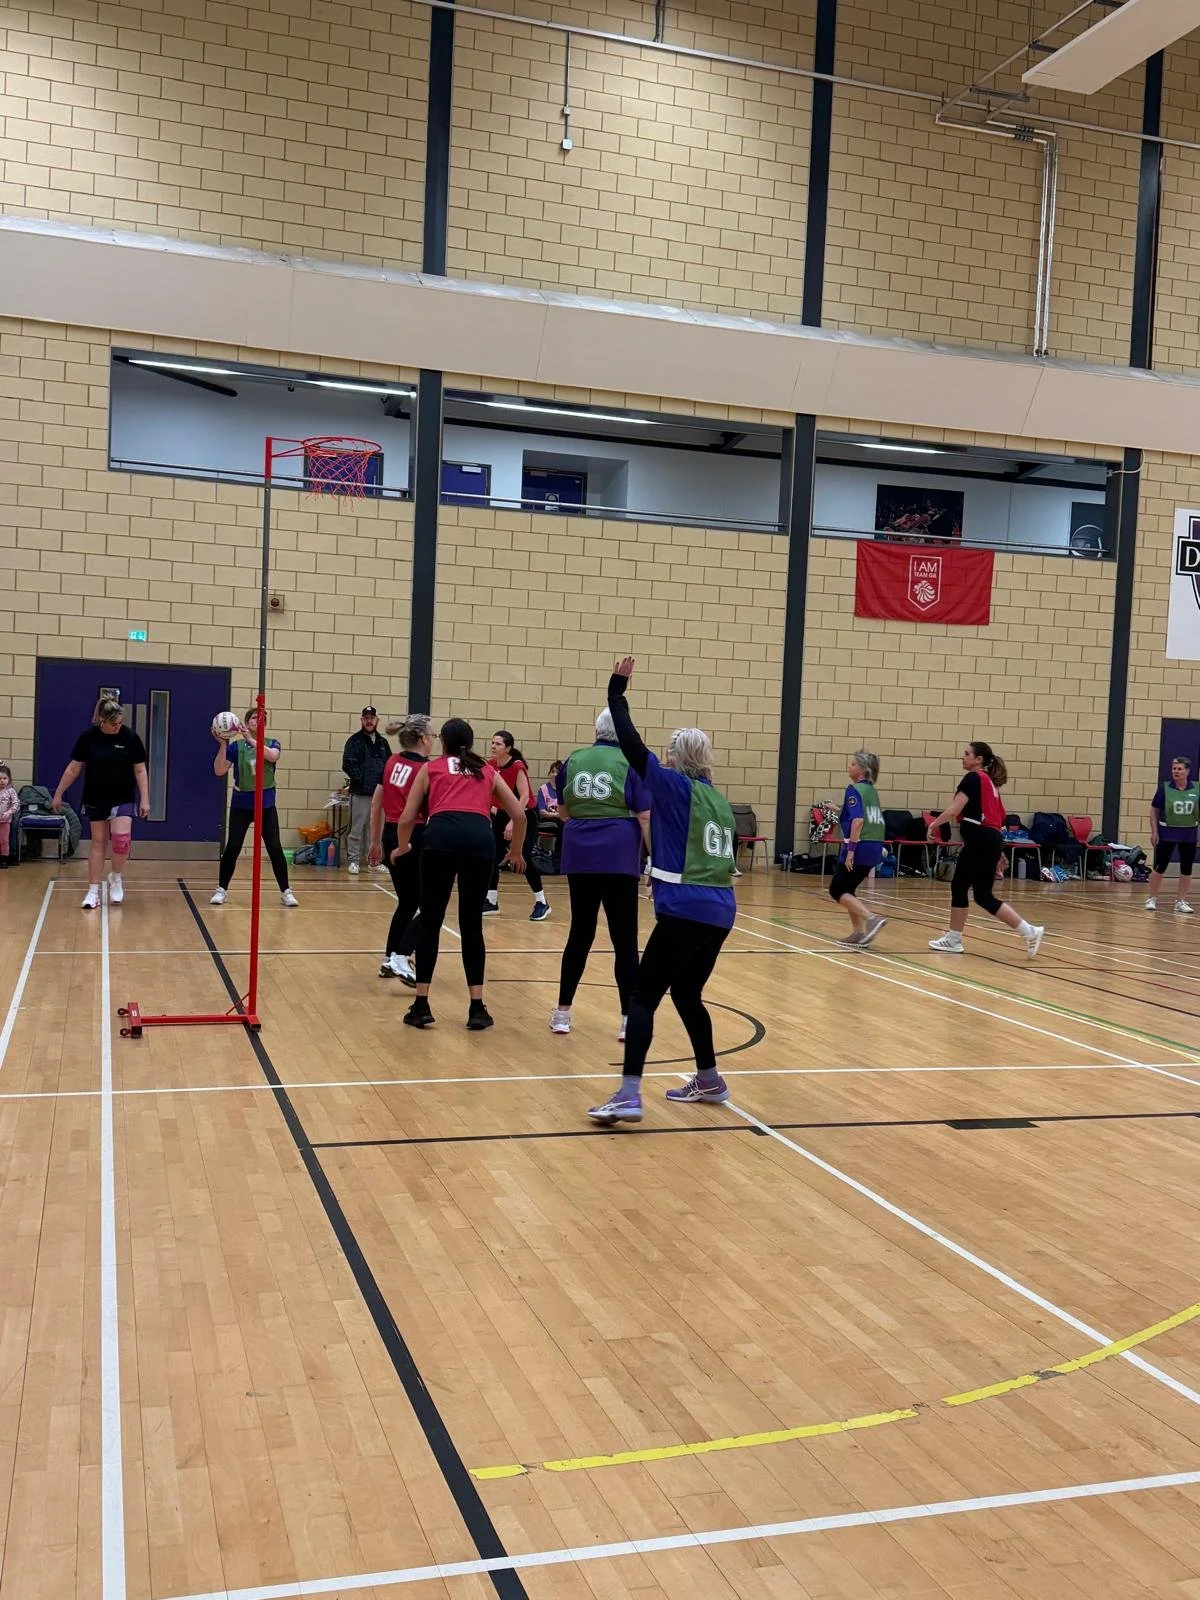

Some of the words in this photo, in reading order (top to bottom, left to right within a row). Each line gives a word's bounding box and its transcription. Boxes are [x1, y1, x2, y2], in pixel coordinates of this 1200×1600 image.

[918, 561, 938, 573] AM
[389, 762, 413, 788] GD
[572, 770, 613, 800] GS
[1173, 800, 1194, 815] GD
